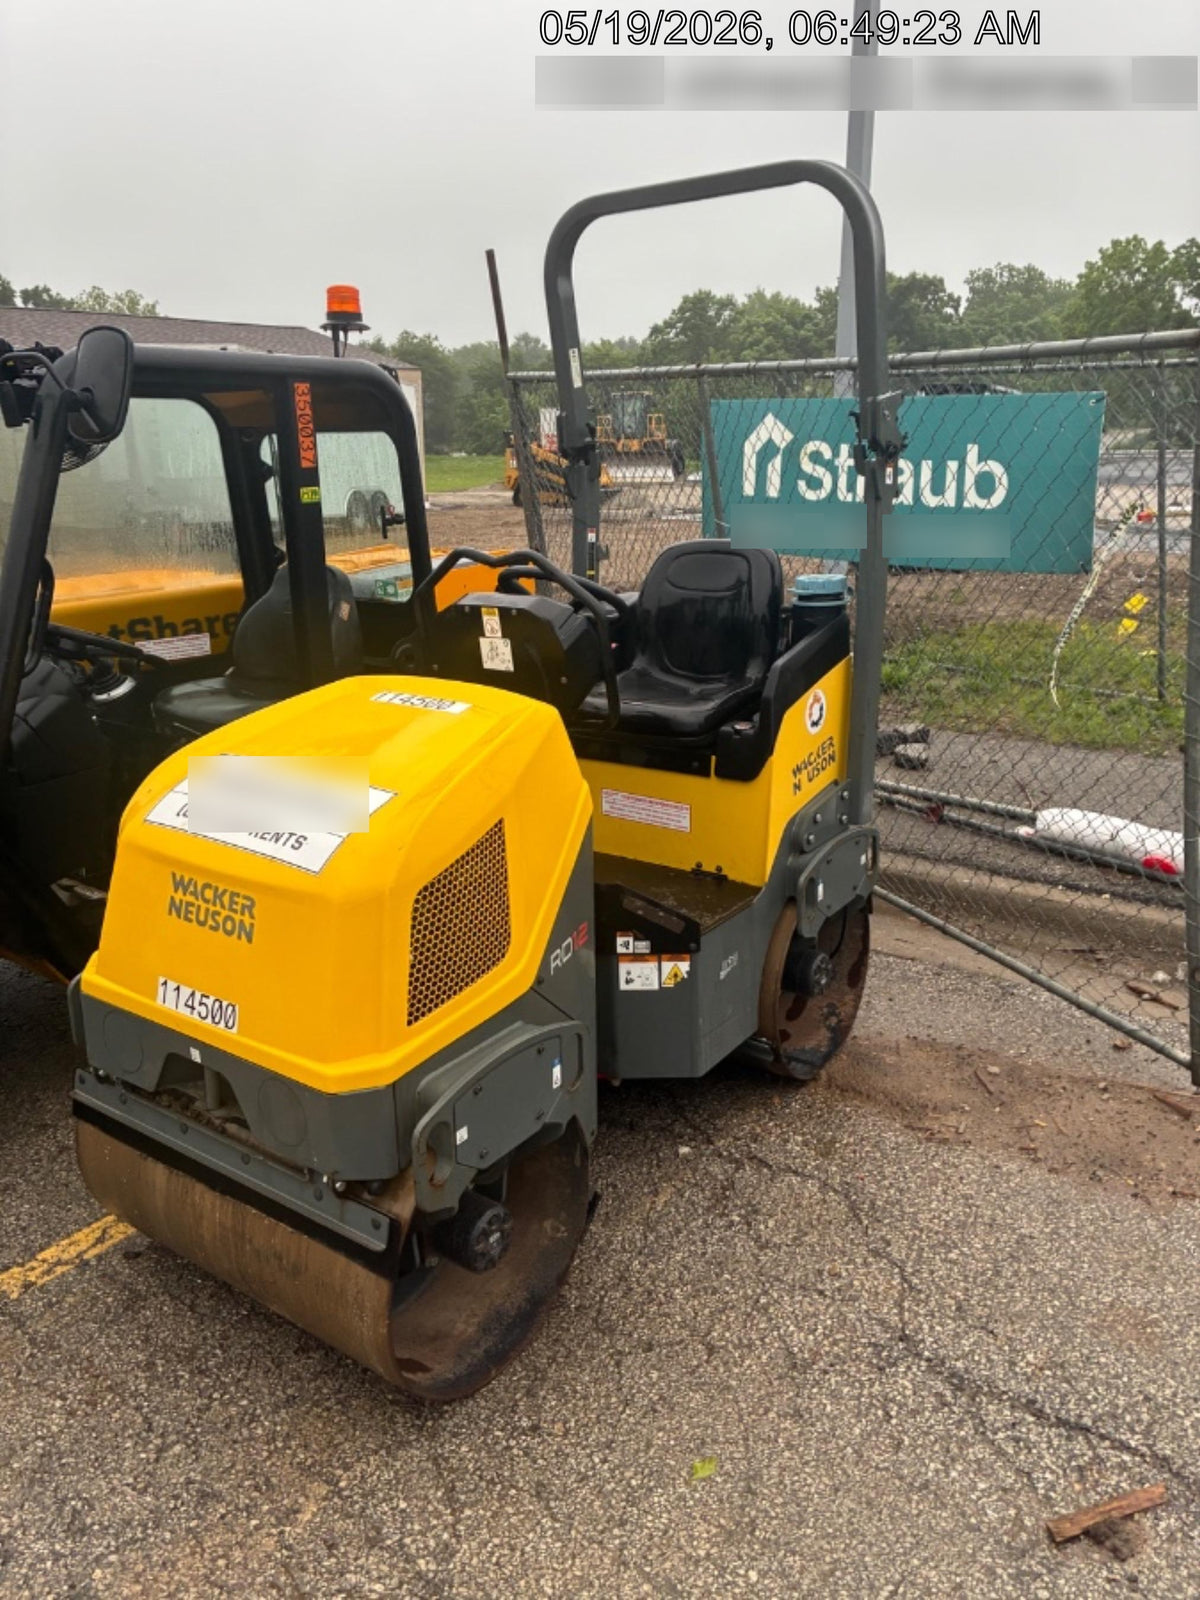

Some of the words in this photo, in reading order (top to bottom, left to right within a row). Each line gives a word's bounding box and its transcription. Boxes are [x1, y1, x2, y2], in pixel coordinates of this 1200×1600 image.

[167, 895, 255, 945] NEUSON
[171, 870, 256, 920] WACKER
[160, 979, 237, 1030] 114500
